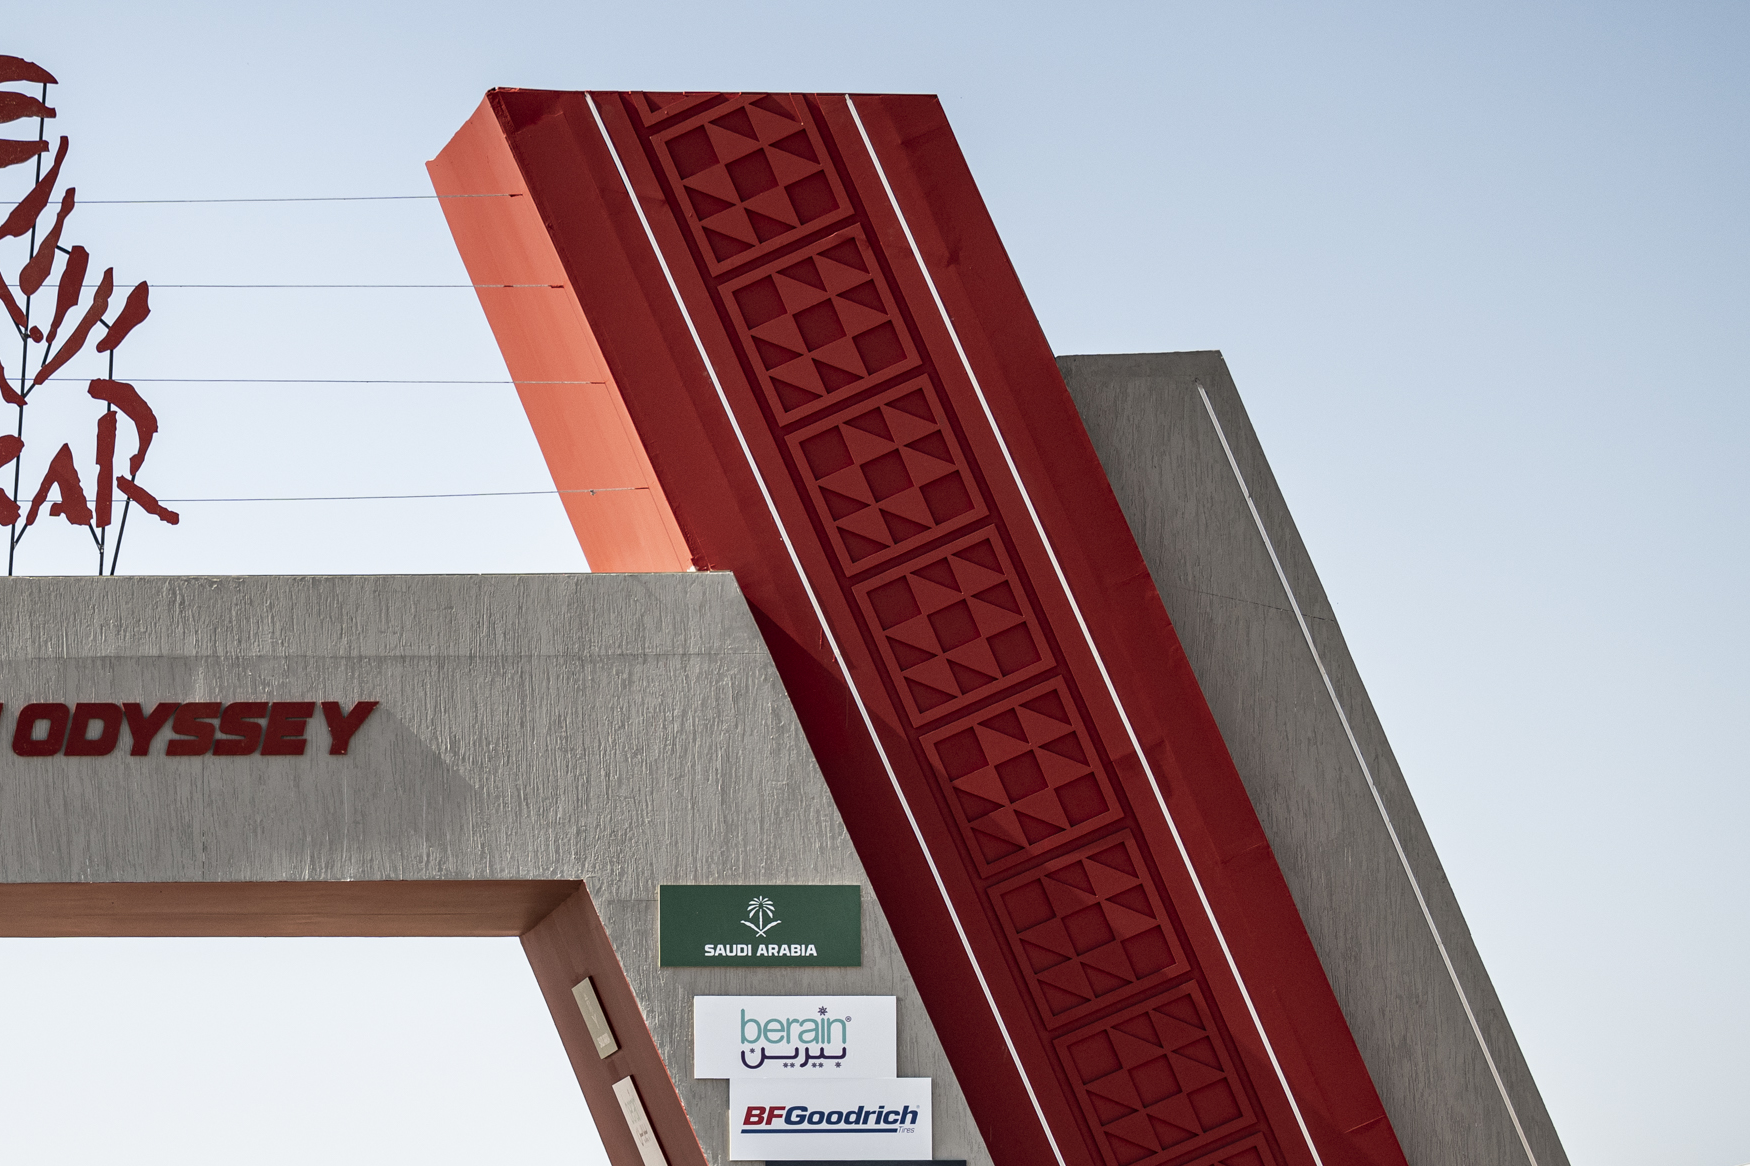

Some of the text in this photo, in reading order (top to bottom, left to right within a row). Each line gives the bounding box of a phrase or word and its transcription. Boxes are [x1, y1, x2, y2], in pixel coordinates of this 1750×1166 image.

[12, 701, 379, 756] ODYSSEY
[704, 944, 818, 957] SAUDI ARABIA
[740, 1006, 847, 1044] berain
[740, 1046, 847, 1070] بيرين
[742, 1105, 919, 1126] BFGoodrich
[897, 1126, 916, 1134] Tires
